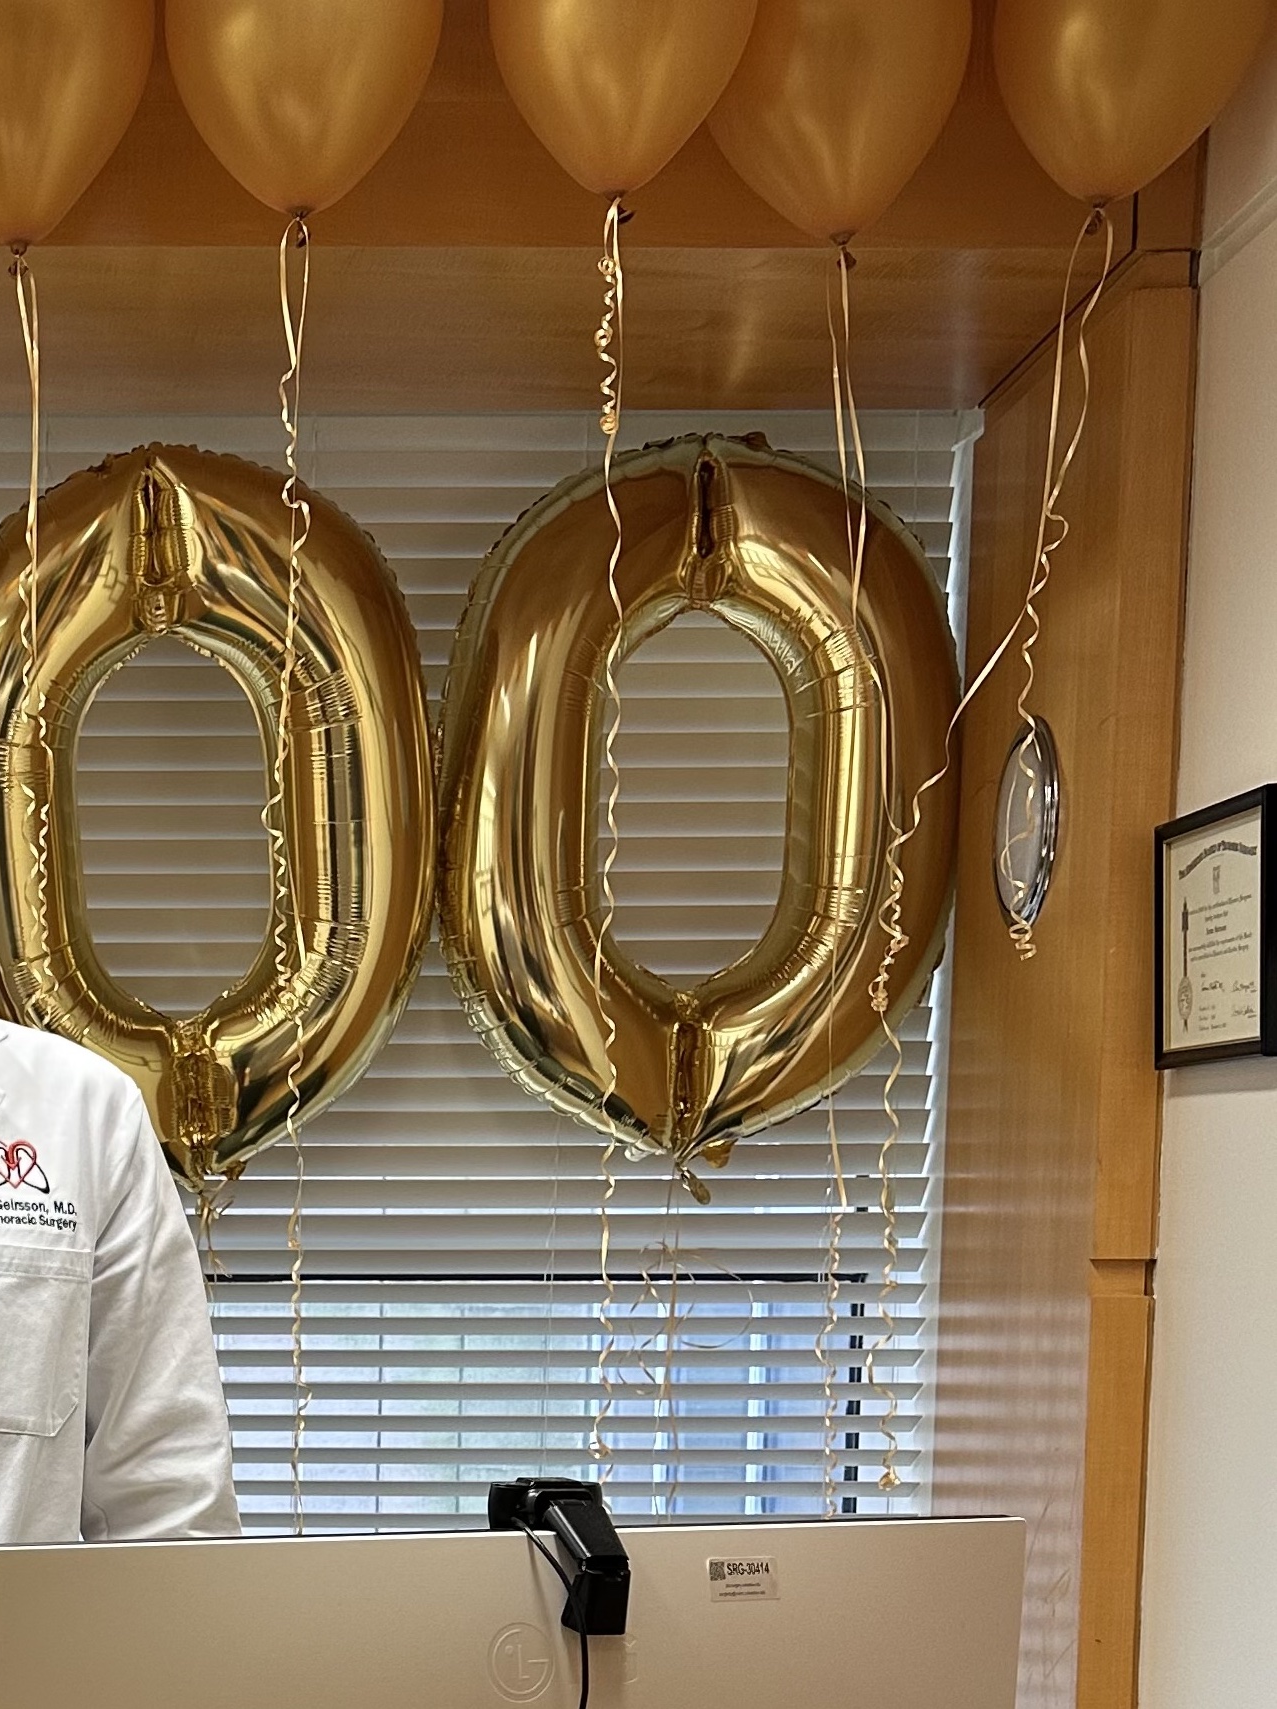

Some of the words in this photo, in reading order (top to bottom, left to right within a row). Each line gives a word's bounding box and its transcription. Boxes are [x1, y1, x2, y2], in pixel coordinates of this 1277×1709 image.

[53, 1200, 78, 1216] M.D.
[39, 1214, 78, 1232] Surgery
[726, 1561, 770, 1576] SRG-30414
